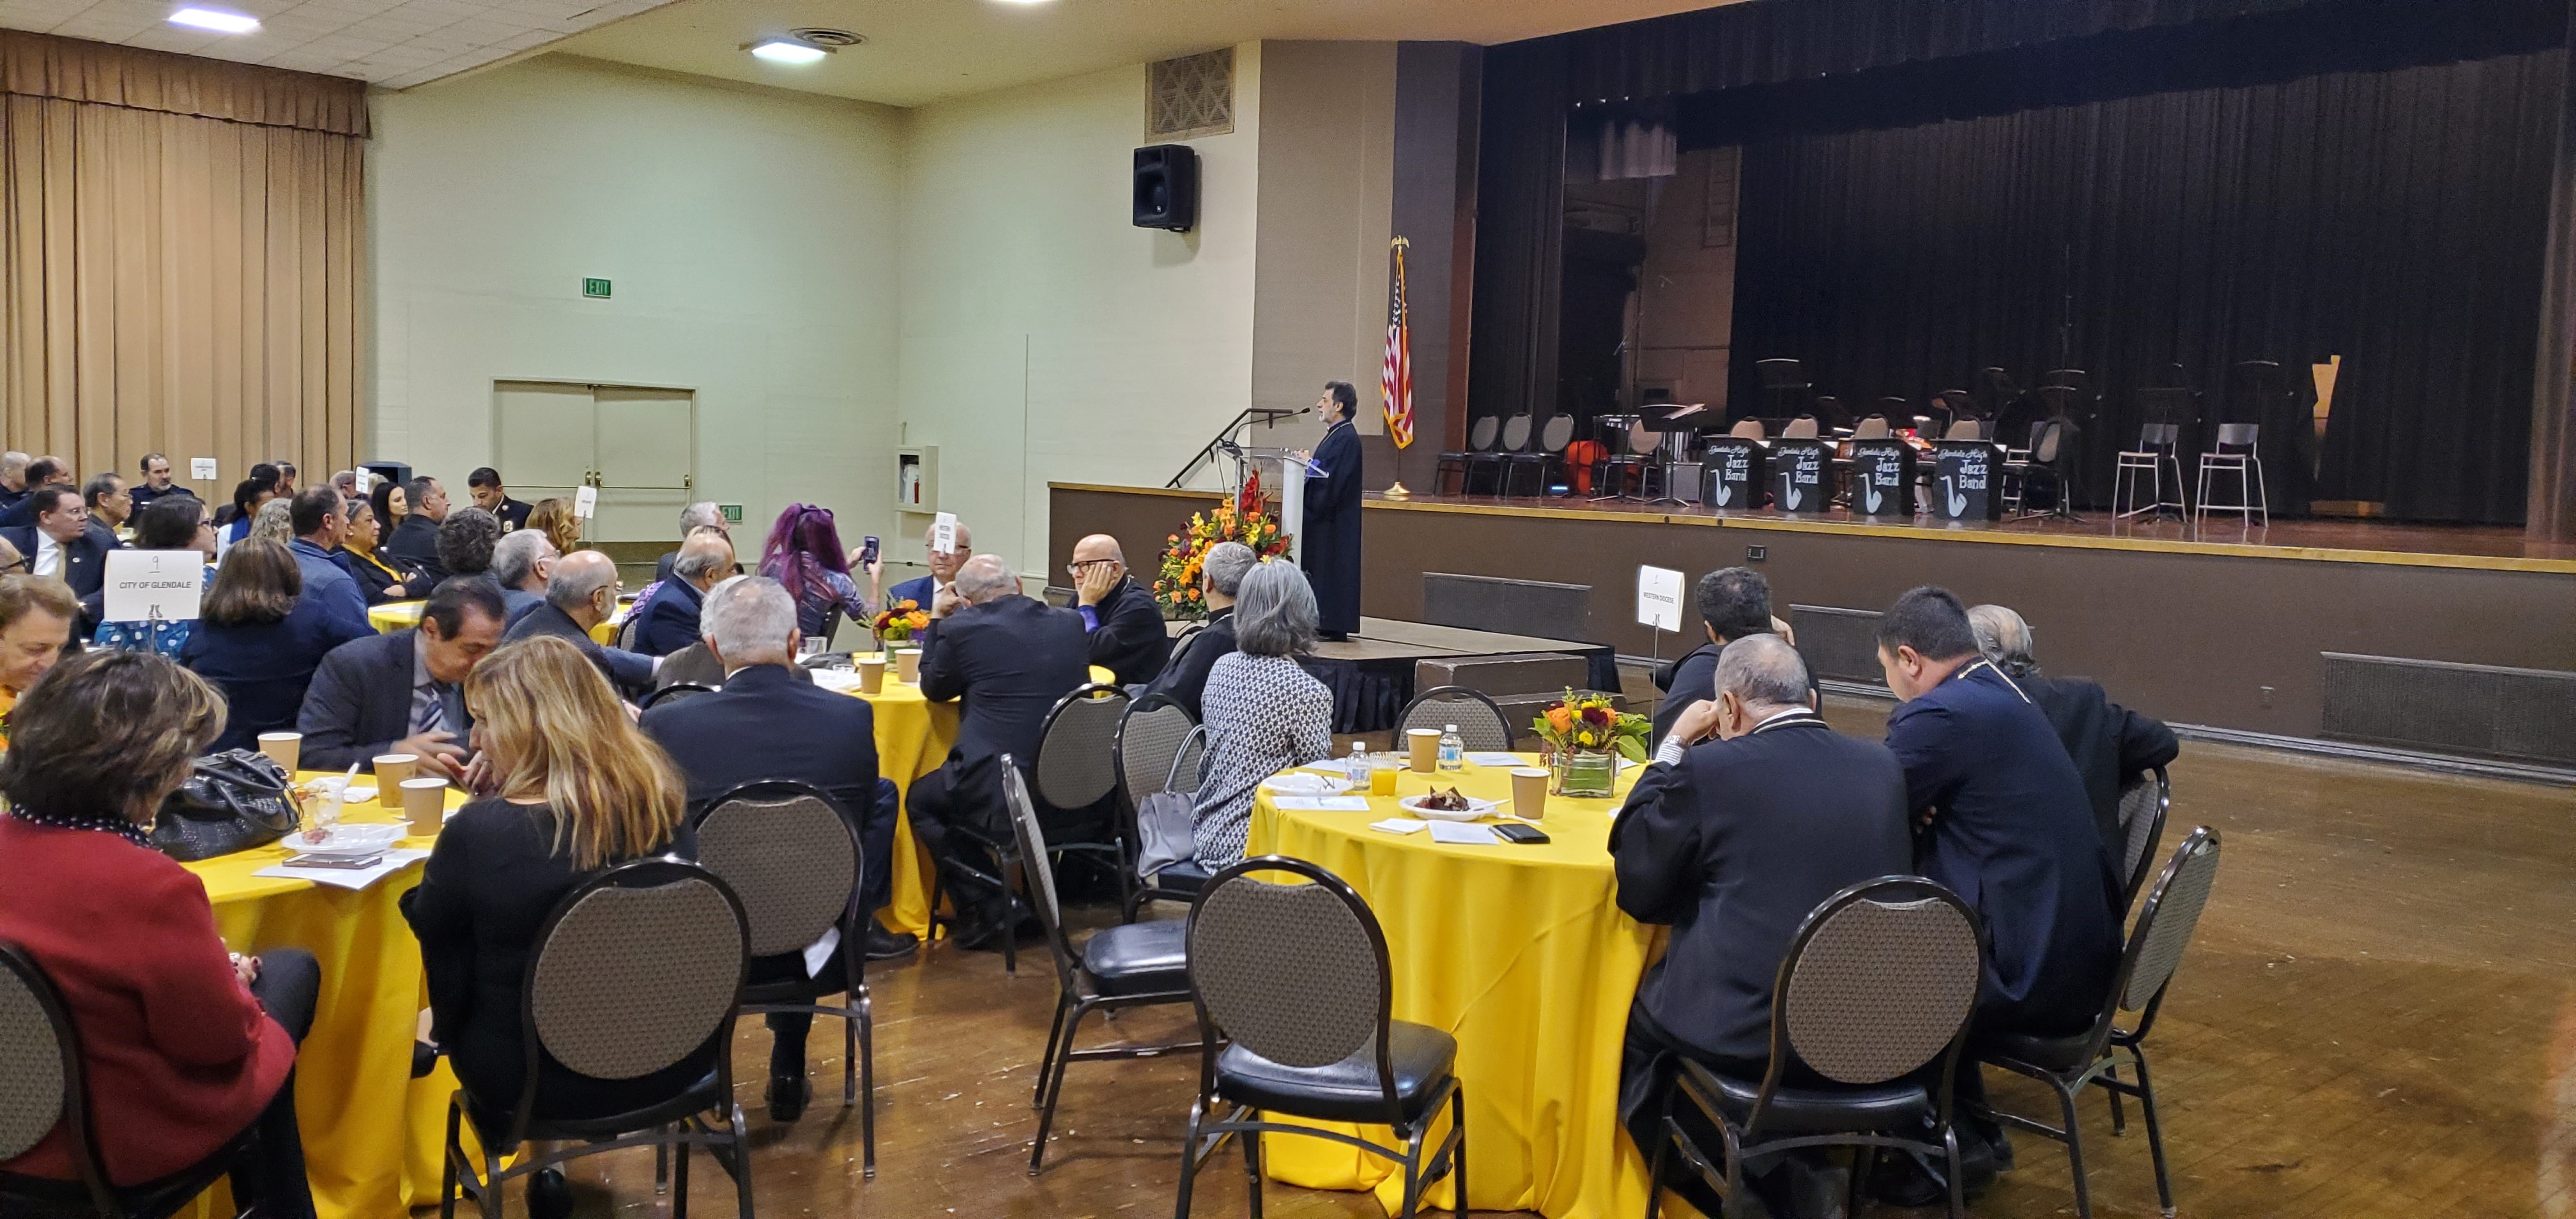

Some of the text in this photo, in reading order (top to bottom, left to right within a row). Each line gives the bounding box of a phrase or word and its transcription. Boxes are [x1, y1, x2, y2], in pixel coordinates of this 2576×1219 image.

[589, 280, 609, 295] EXIT
[1730, 445, 1749, 457] High
[1800, 447, 1820, 459] High
[1880, 447, 1899, 461] High
[1965, 448, 1988, 463] High
[1726, 454, 1749, 468] Jazz
[1796, 456, 1820, 470] Jazz
[1876, 457, 1899, 472] Jazz
[1959, 459, 1988, 475] Jazz
[1725, 468, 1747, 480] Band
[1795, 471, 1818, 484] Band
[1875, 473, 1899, 486] Band
[1959, 475, 1986, 489] Band
[152, 556, 158, 571] 9
